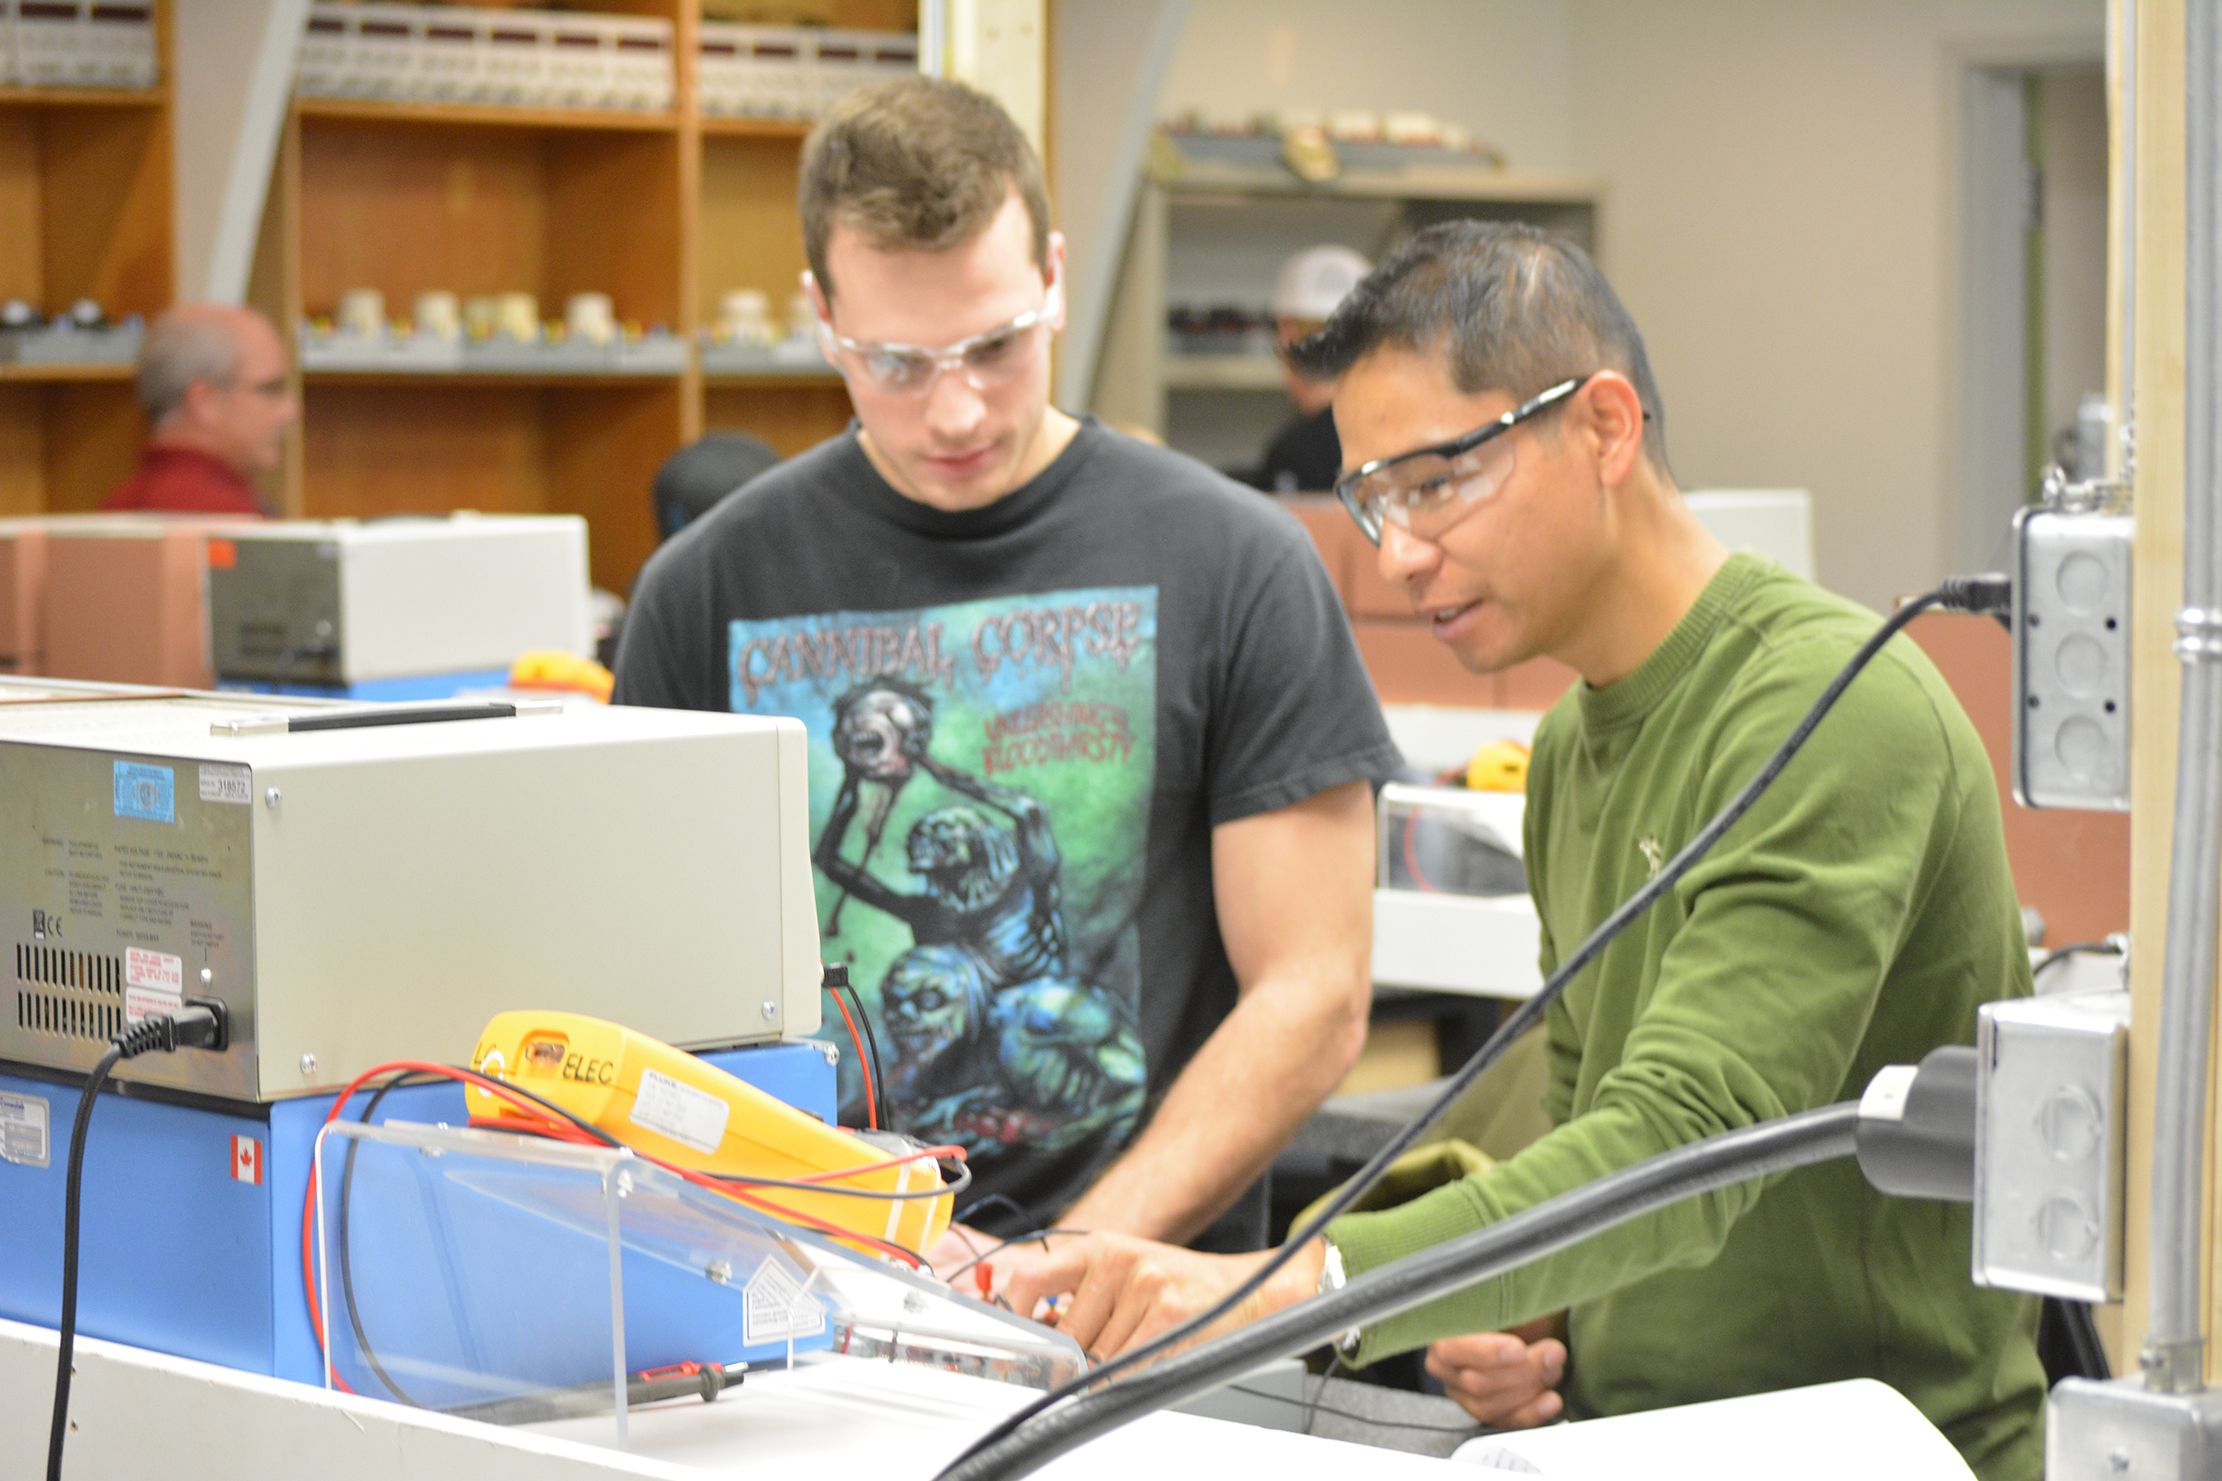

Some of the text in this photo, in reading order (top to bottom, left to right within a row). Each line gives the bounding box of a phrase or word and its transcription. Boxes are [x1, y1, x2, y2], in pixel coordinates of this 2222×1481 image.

[739, 601, 1142, 704] CANNIBAL CORPSE
[562, 1053, 614, 1085] ELEC
